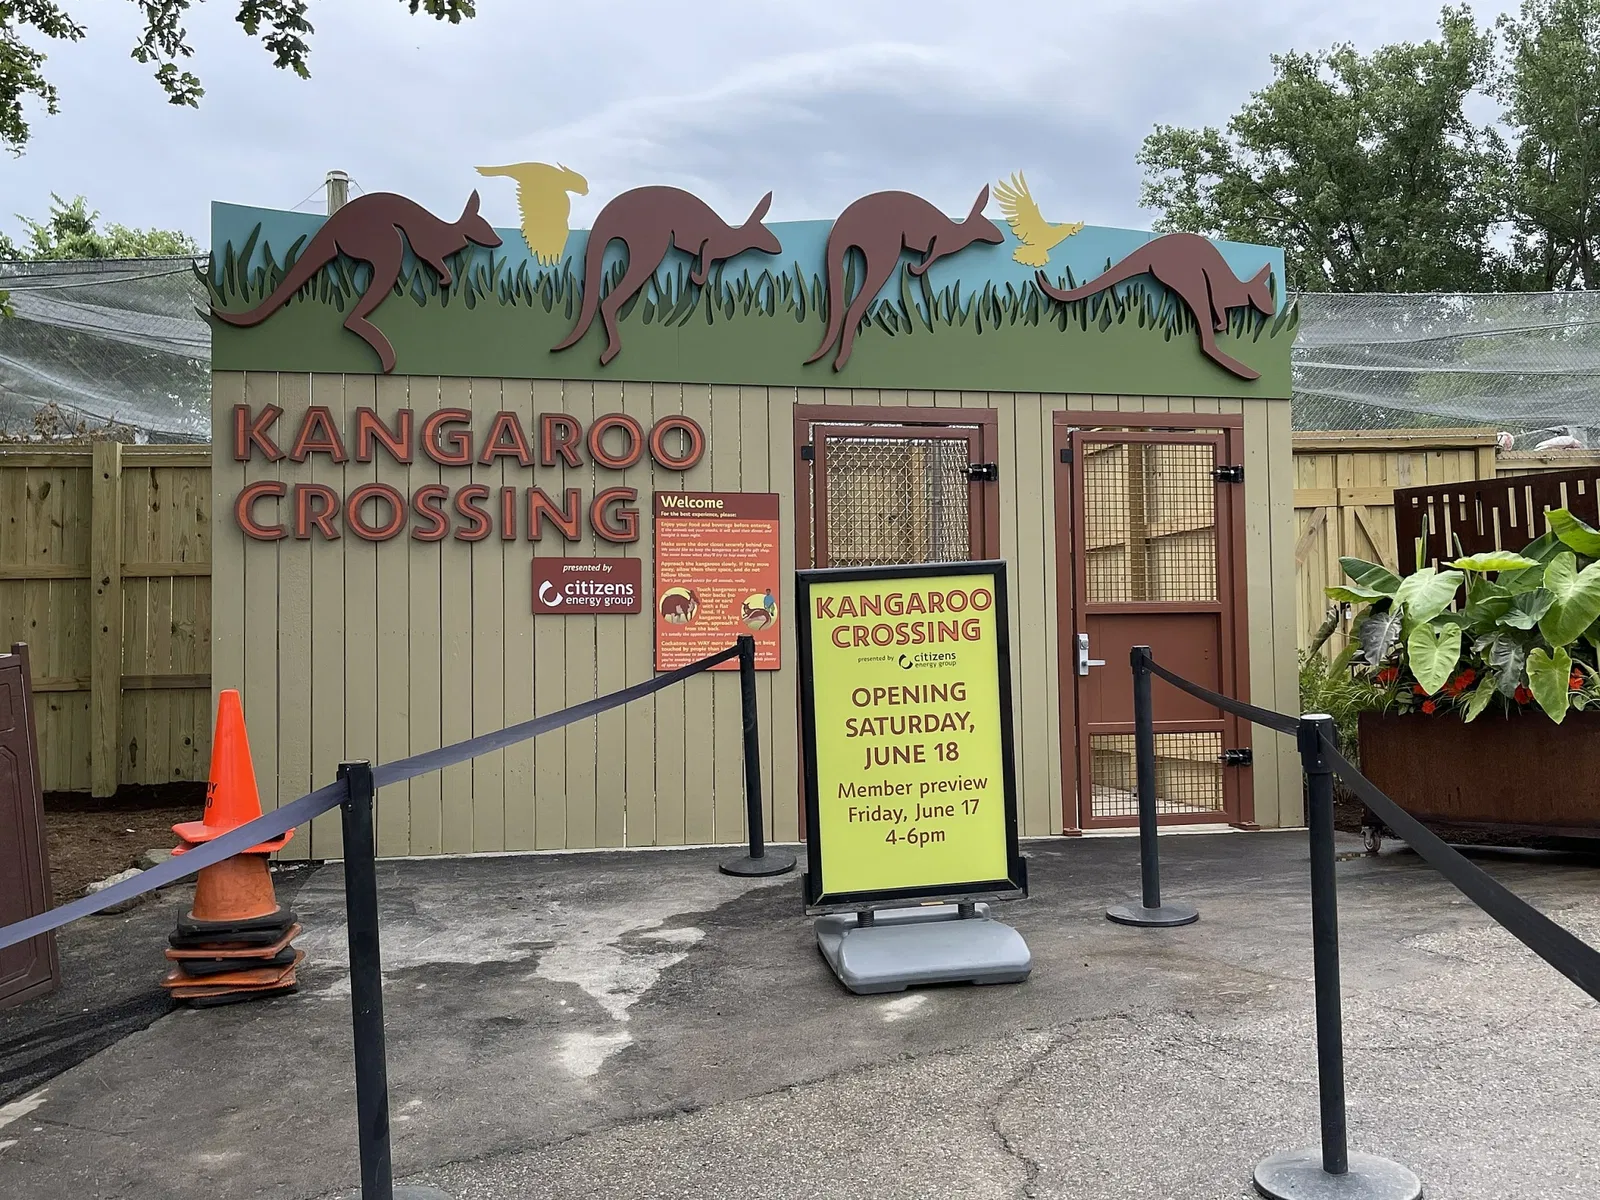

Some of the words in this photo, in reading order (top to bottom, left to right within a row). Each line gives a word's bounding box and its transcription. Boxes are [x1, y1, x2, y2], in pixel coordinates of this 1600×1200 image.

[233, 403, 706, 470] KANGAROO
[234, 480, 640, 543] CROSSING
[661, 496, 724, 508] Welcome
[562, 564, 600, 573] presented
[602, 564, 612, 573] by
[565, 580, 634, 595] citizens
[566, 596, 601, 606] energy
[604, 596, 634, 606] group
[816, 588, 992, 619] KANGAROO
[832, 618, 980, 648] CROSSING
[914, 652, 956, 662] citizens
[852, 682, 966, 708] OPENING
[846, 711, 975, 738] SATURDAY,
[864, 744, 926, 770] JUNE
[934, 742, 959, 762] 18
[838, 780, 912, 798] Member
[920, 775, 988, 798] preview
[849, 805, 908, 824] Friday,
[915, 804, 954, 821] June
[962, 799, 980, 815] 17
[886, 828, 945, 848] 4-6pm
